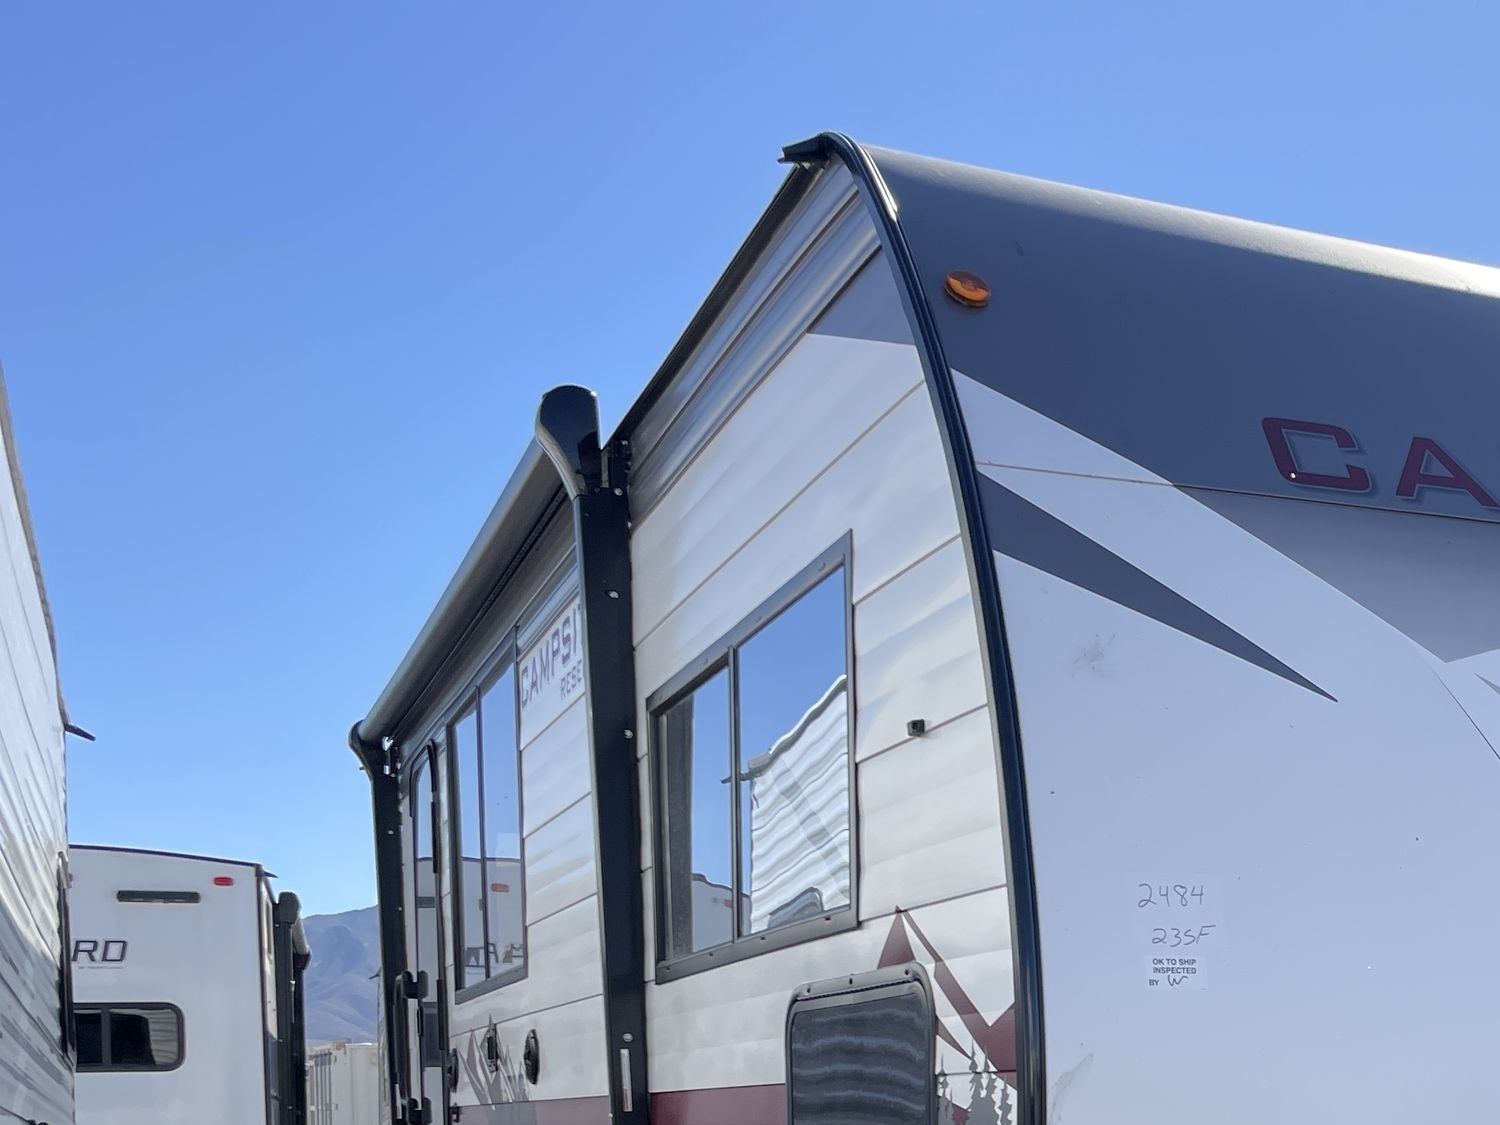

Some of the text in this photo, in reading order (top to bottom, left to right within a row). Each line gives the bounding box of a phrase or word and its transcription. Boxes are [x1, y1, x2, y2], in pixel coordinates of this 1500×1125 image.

[521, 603, 581, 710] CAMPSI
[1137, 883, 1205, 908] 2484
[1152, 958, 1197, 966] OK TO SHIP
[1152, 967, 1197, 975] INSPECTED
[1148, 979, 1160, 987] BY
